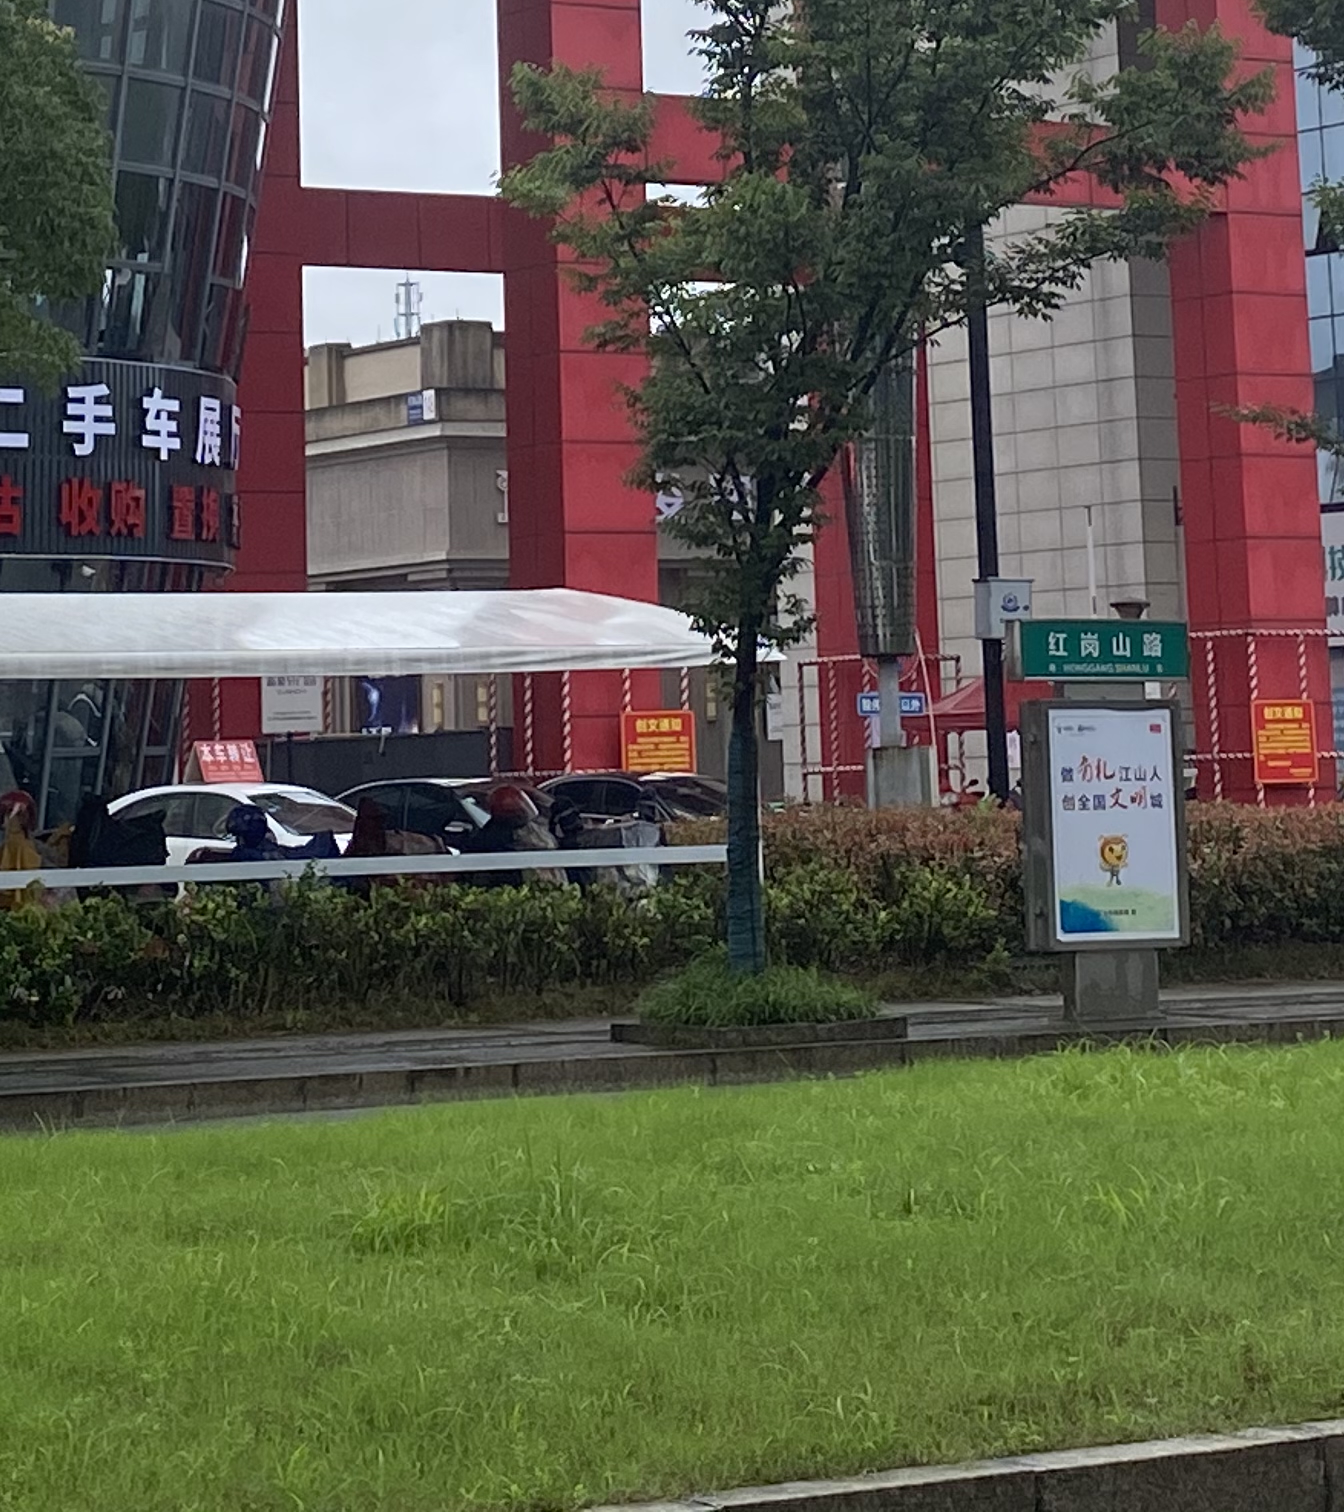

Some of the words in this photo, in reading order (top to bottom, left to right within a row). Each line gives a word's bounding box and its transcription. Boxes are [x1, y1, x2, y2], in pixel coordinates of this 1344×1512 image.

[60, 476, 146, 537] 收购
[1047, 631, 1162, 658] 红岗山路
